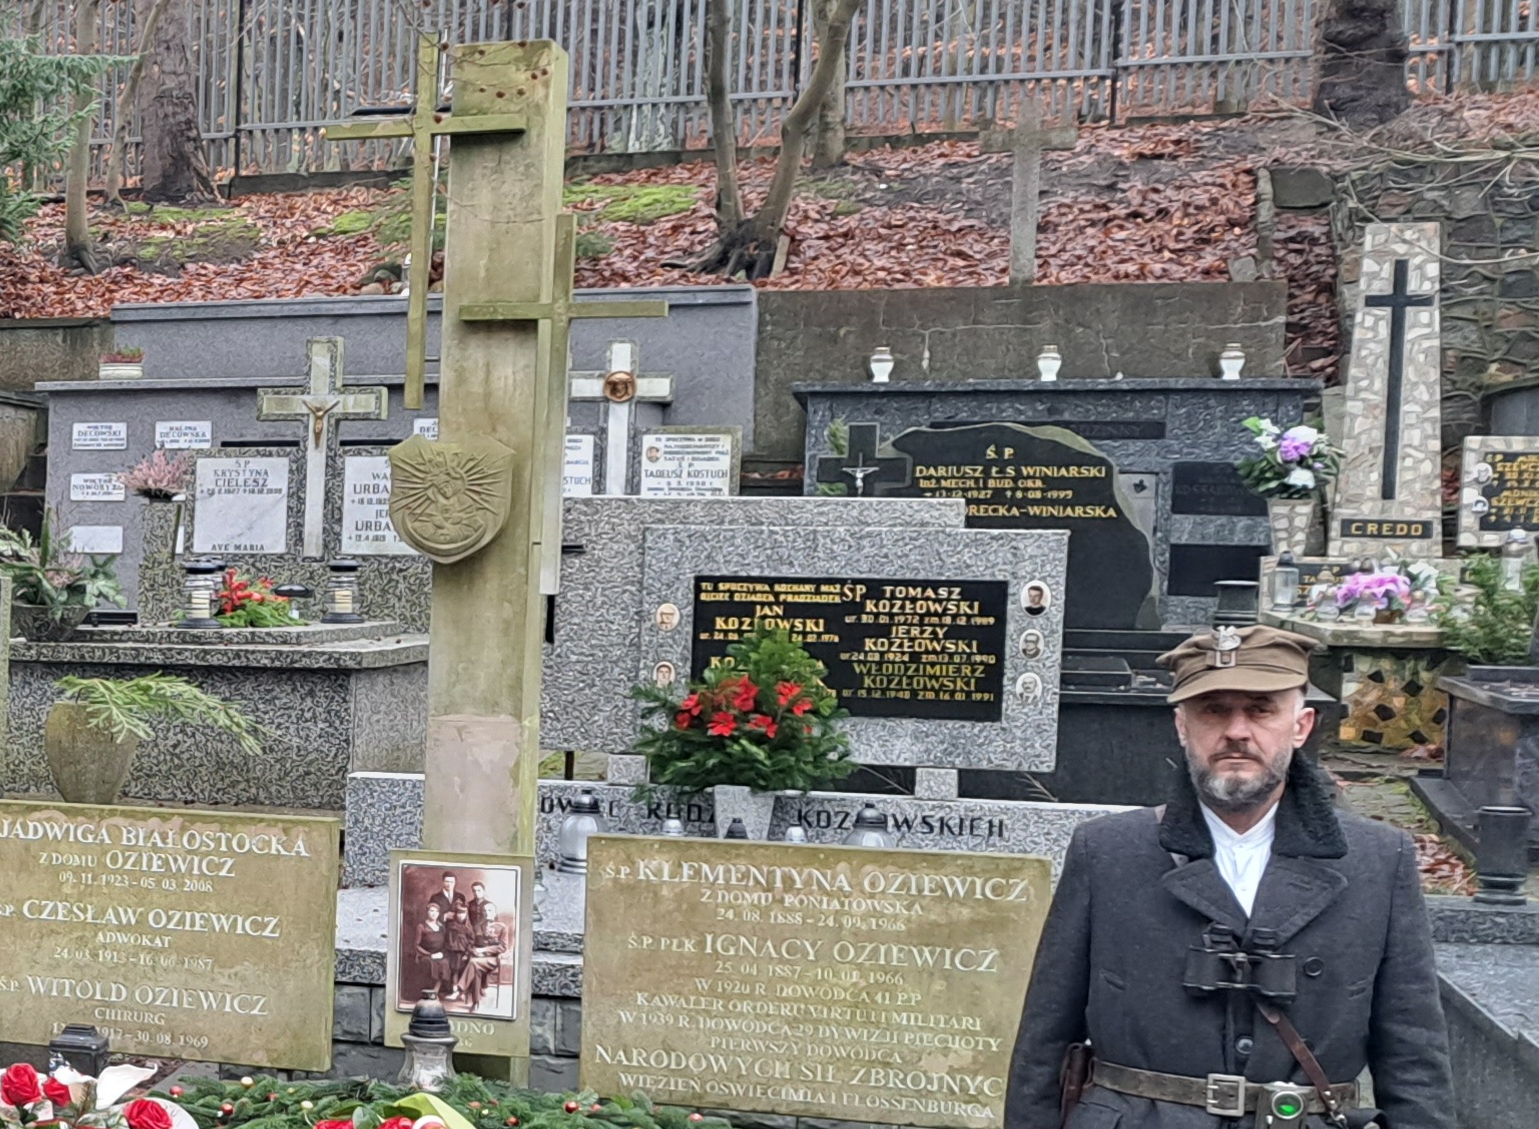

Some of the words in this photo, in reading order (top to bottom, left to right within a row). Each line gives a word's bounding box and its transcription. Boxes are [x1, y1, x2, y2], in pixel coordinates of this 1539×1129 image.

[214, 469, 269, 478] KRYSTYNA
[915, 465, 984, 478] DARIUSZ
[1021, 465, 1107, 478] WINIARSKI
[215, 478, 268, 488] CIELESZ
[563, 475, 591, 486] STUCH
[353, 483, 390, 495] URBA
[355, 520, 392, 532] URBA
[1351, 522, 1423, 536] CREDO
[882, 586, 962, 599] TOMASZ
[755, 604, 784, 617] JAN
[865, 600, 980, 614] KOZŁOWSKI
[890, 626, 948, 639] JERZY
[864, 639, 978, 653] KOZŁOWSKI
[853, 662, 986, 678] WŁODZIMIERZ
[863, 676, 976, 691] KOZŁOWSKI
[797, 807, 1005, 838] KOZWSKICH
[121, 826, 310, 857] BIAŁOSTOCKA
[39, 852, 50, 866] Z
[52, 853, 97, 867] DOMU
[106, 850, 236, 877] OZIEWICZ
[637, 859, 852, 892] KLEMENTYNA
[864, 871, 1030, 902] OZIEWICZ
[700, 888, 712, 903] Z
[717, 890, 772, 906] DOMU
[783, 892, 923, 915] PONIATOWSKA
[23, 899, 144, 926] CZESŁAW
[148, 908, 281, 938] OZIEWICZ
[871, 917, 906, 931] 1966
[95, 930, 173, 948] ADWOKAT
[704, 932, 825, 961] IGNACY
[833, 940, 999, 973] OZIEWICZ
[869, 970, 904, 986] 1966
[25, 975, 127, 1003] WITOLD
[134, 984, 269, 1015] OZIEWICZ
[694, 977, 712, 993] W
[776, 982, 871, 1004] DOWÓDCA
[94, 1006, 166, 1026] CHIRURG
[637, 991, 724, 1011] KAWALER
[728, 999, 804, 1018] ORDERU
[891, 1011, 983, 1032] MILITARI
[618, 1010, 636, 1025] W
[641, 1012, 674, 1027] 1939
[903, 1032, 1003, 1052] PIECHOTY
[179, 1034, 209, 1049] 1969
[710, 1035, 802, 1056] PIERWSZY
[594, 1043, 792, 1080] NARODOWYCH
[799, 1063, 843, 1085] SIŁ
[849, 1066, 1005, 1097] ZBROJNYC
